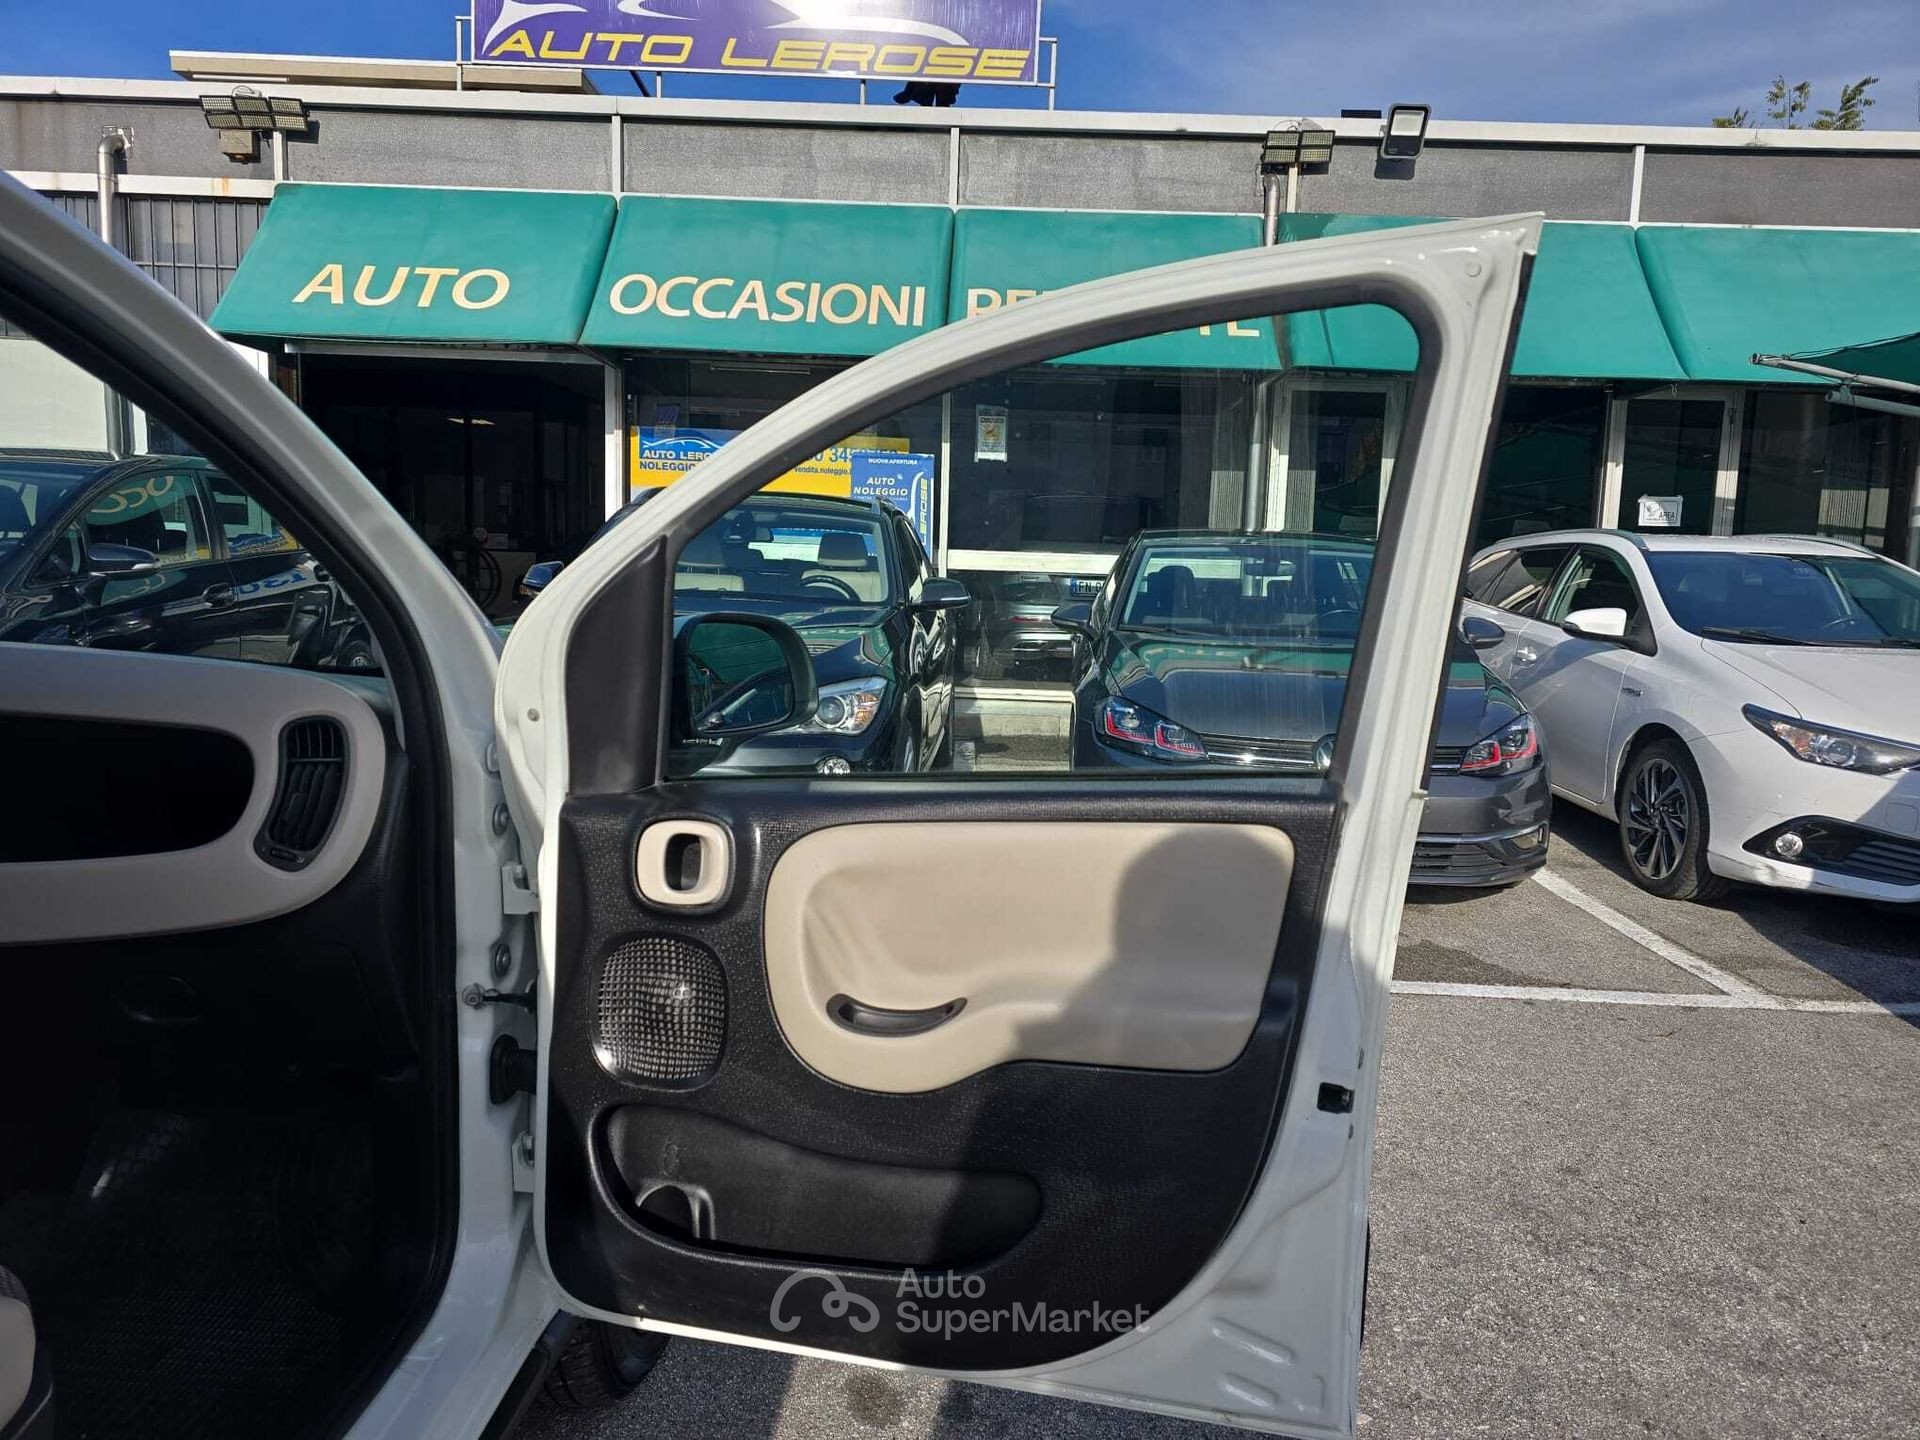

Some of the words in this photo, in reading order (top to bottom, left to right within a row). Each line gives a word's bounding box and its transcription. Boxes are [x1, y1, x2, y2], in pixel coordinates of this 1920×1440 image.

[489, 30, 694, 63] AUTO
[721, 38, 1031, 78] LEROSE
[291, 263, 510, 310] AUTO
[609, 273, 926, 327] OCCASIONI
[642, 449, 676, 459] AUTO
[853, 486, 908, 496] NOLEGGIO
[866, 477, 895, 486] AUTO
[920, 477, 928, 546] LEROSE
